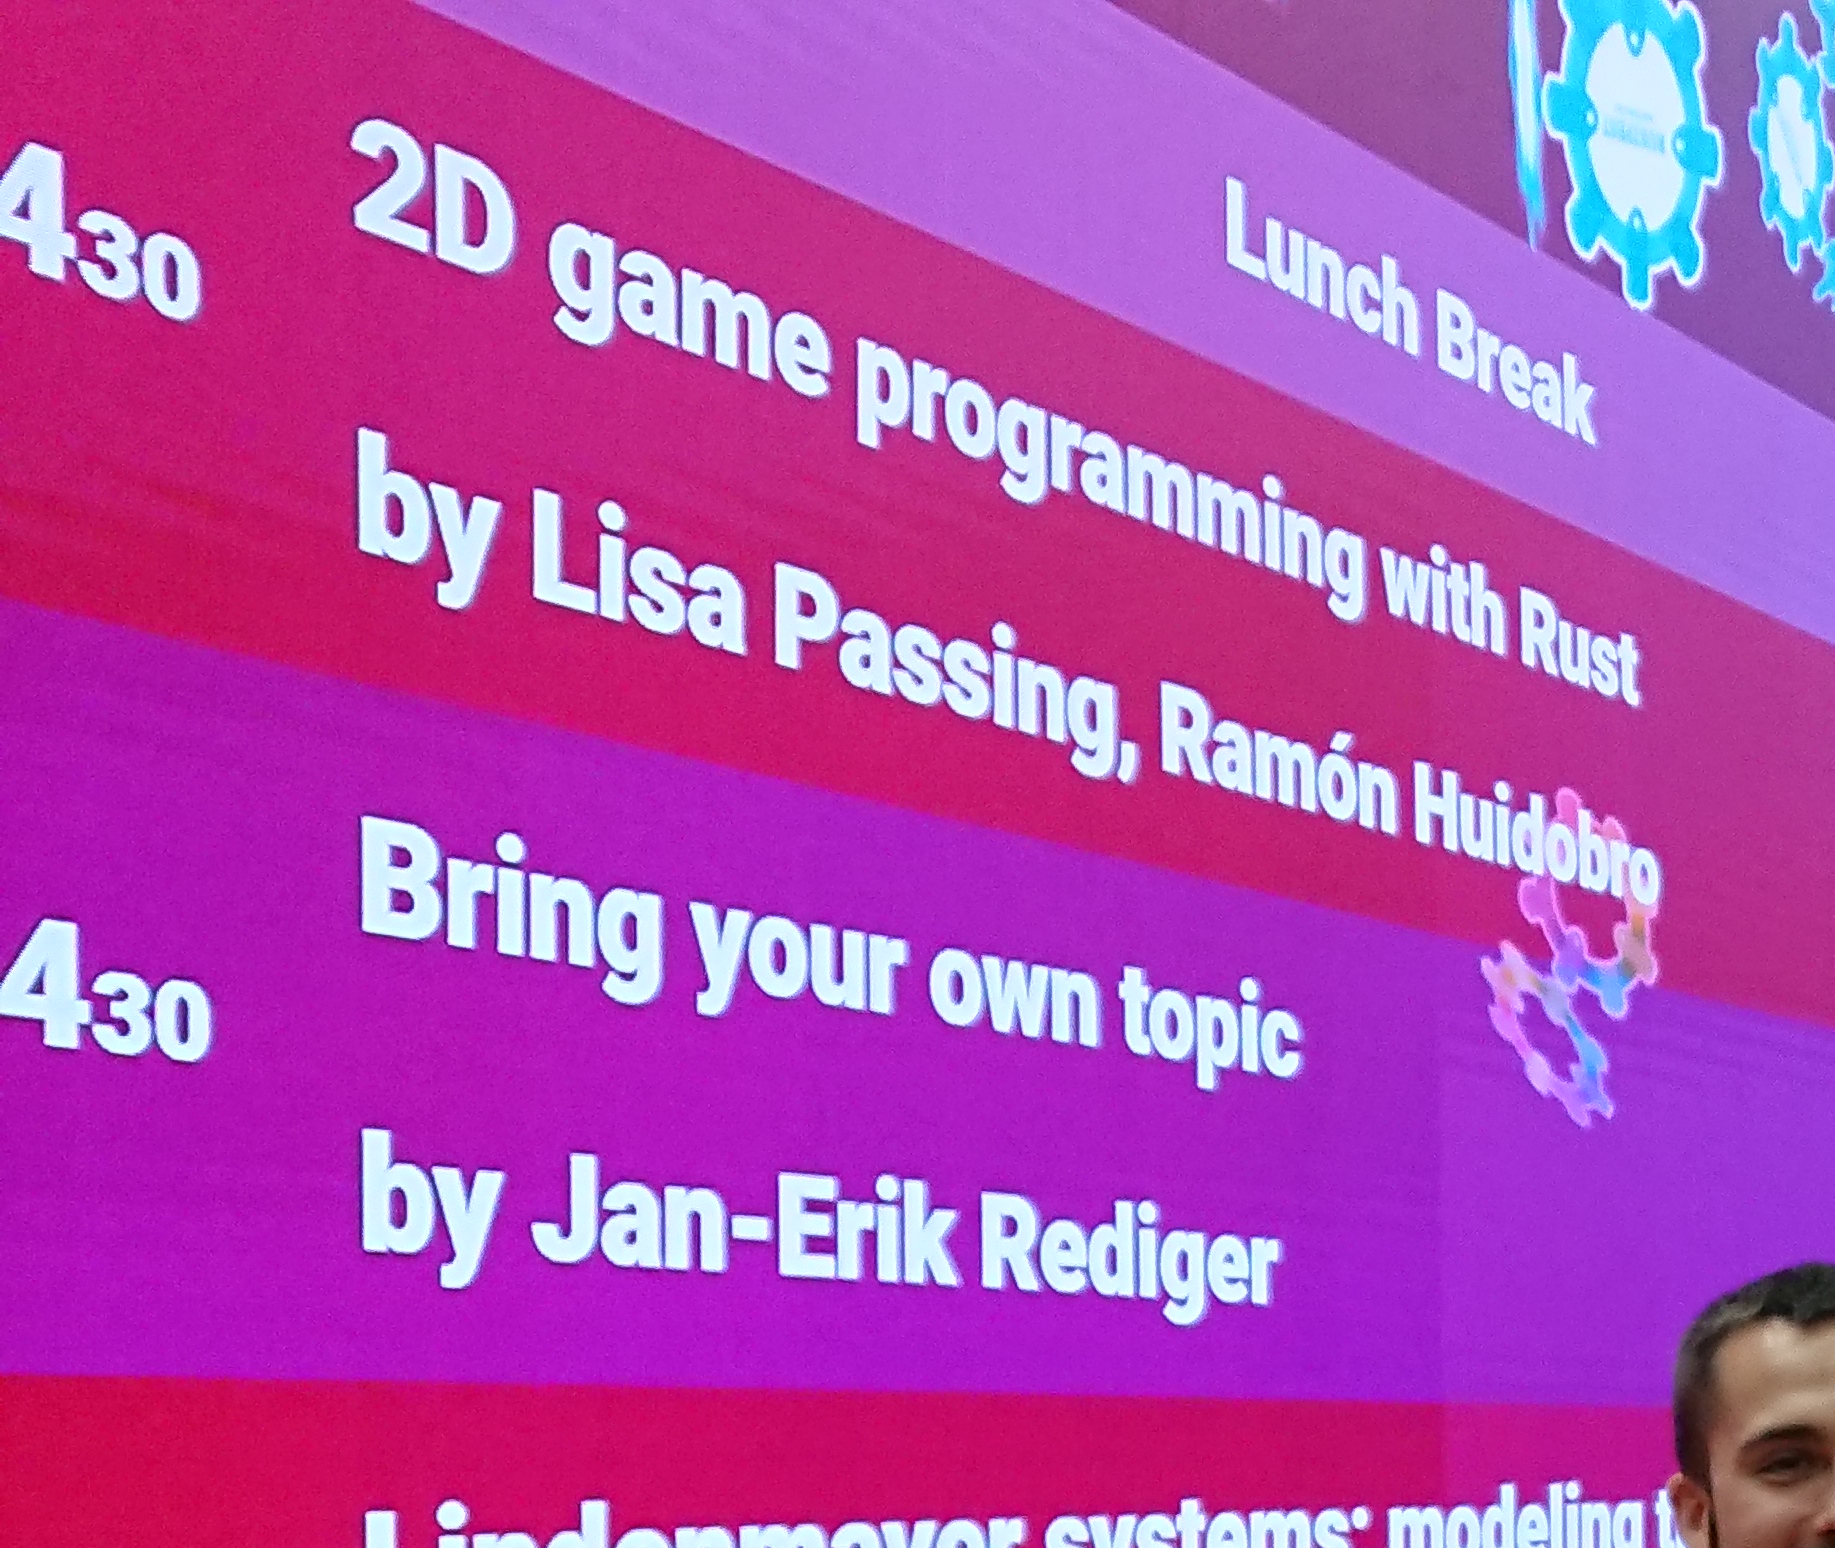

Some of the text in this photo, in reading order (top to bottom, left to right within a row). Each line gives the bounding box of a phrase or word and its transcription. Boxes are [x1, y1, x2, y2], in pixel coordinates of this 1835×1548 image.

[351, 120, 1641, 707] 2D game programming with Rust
[1226, 176, 1598, 447] Lunch Break
[358, 428, 1661, 908] by Lisa Passing, Ramón Huidobro
[361, 816, 1301, 1089] Bring your own topic
[362, 1129, 1281, 1325] by Jan-Erik Rediger
